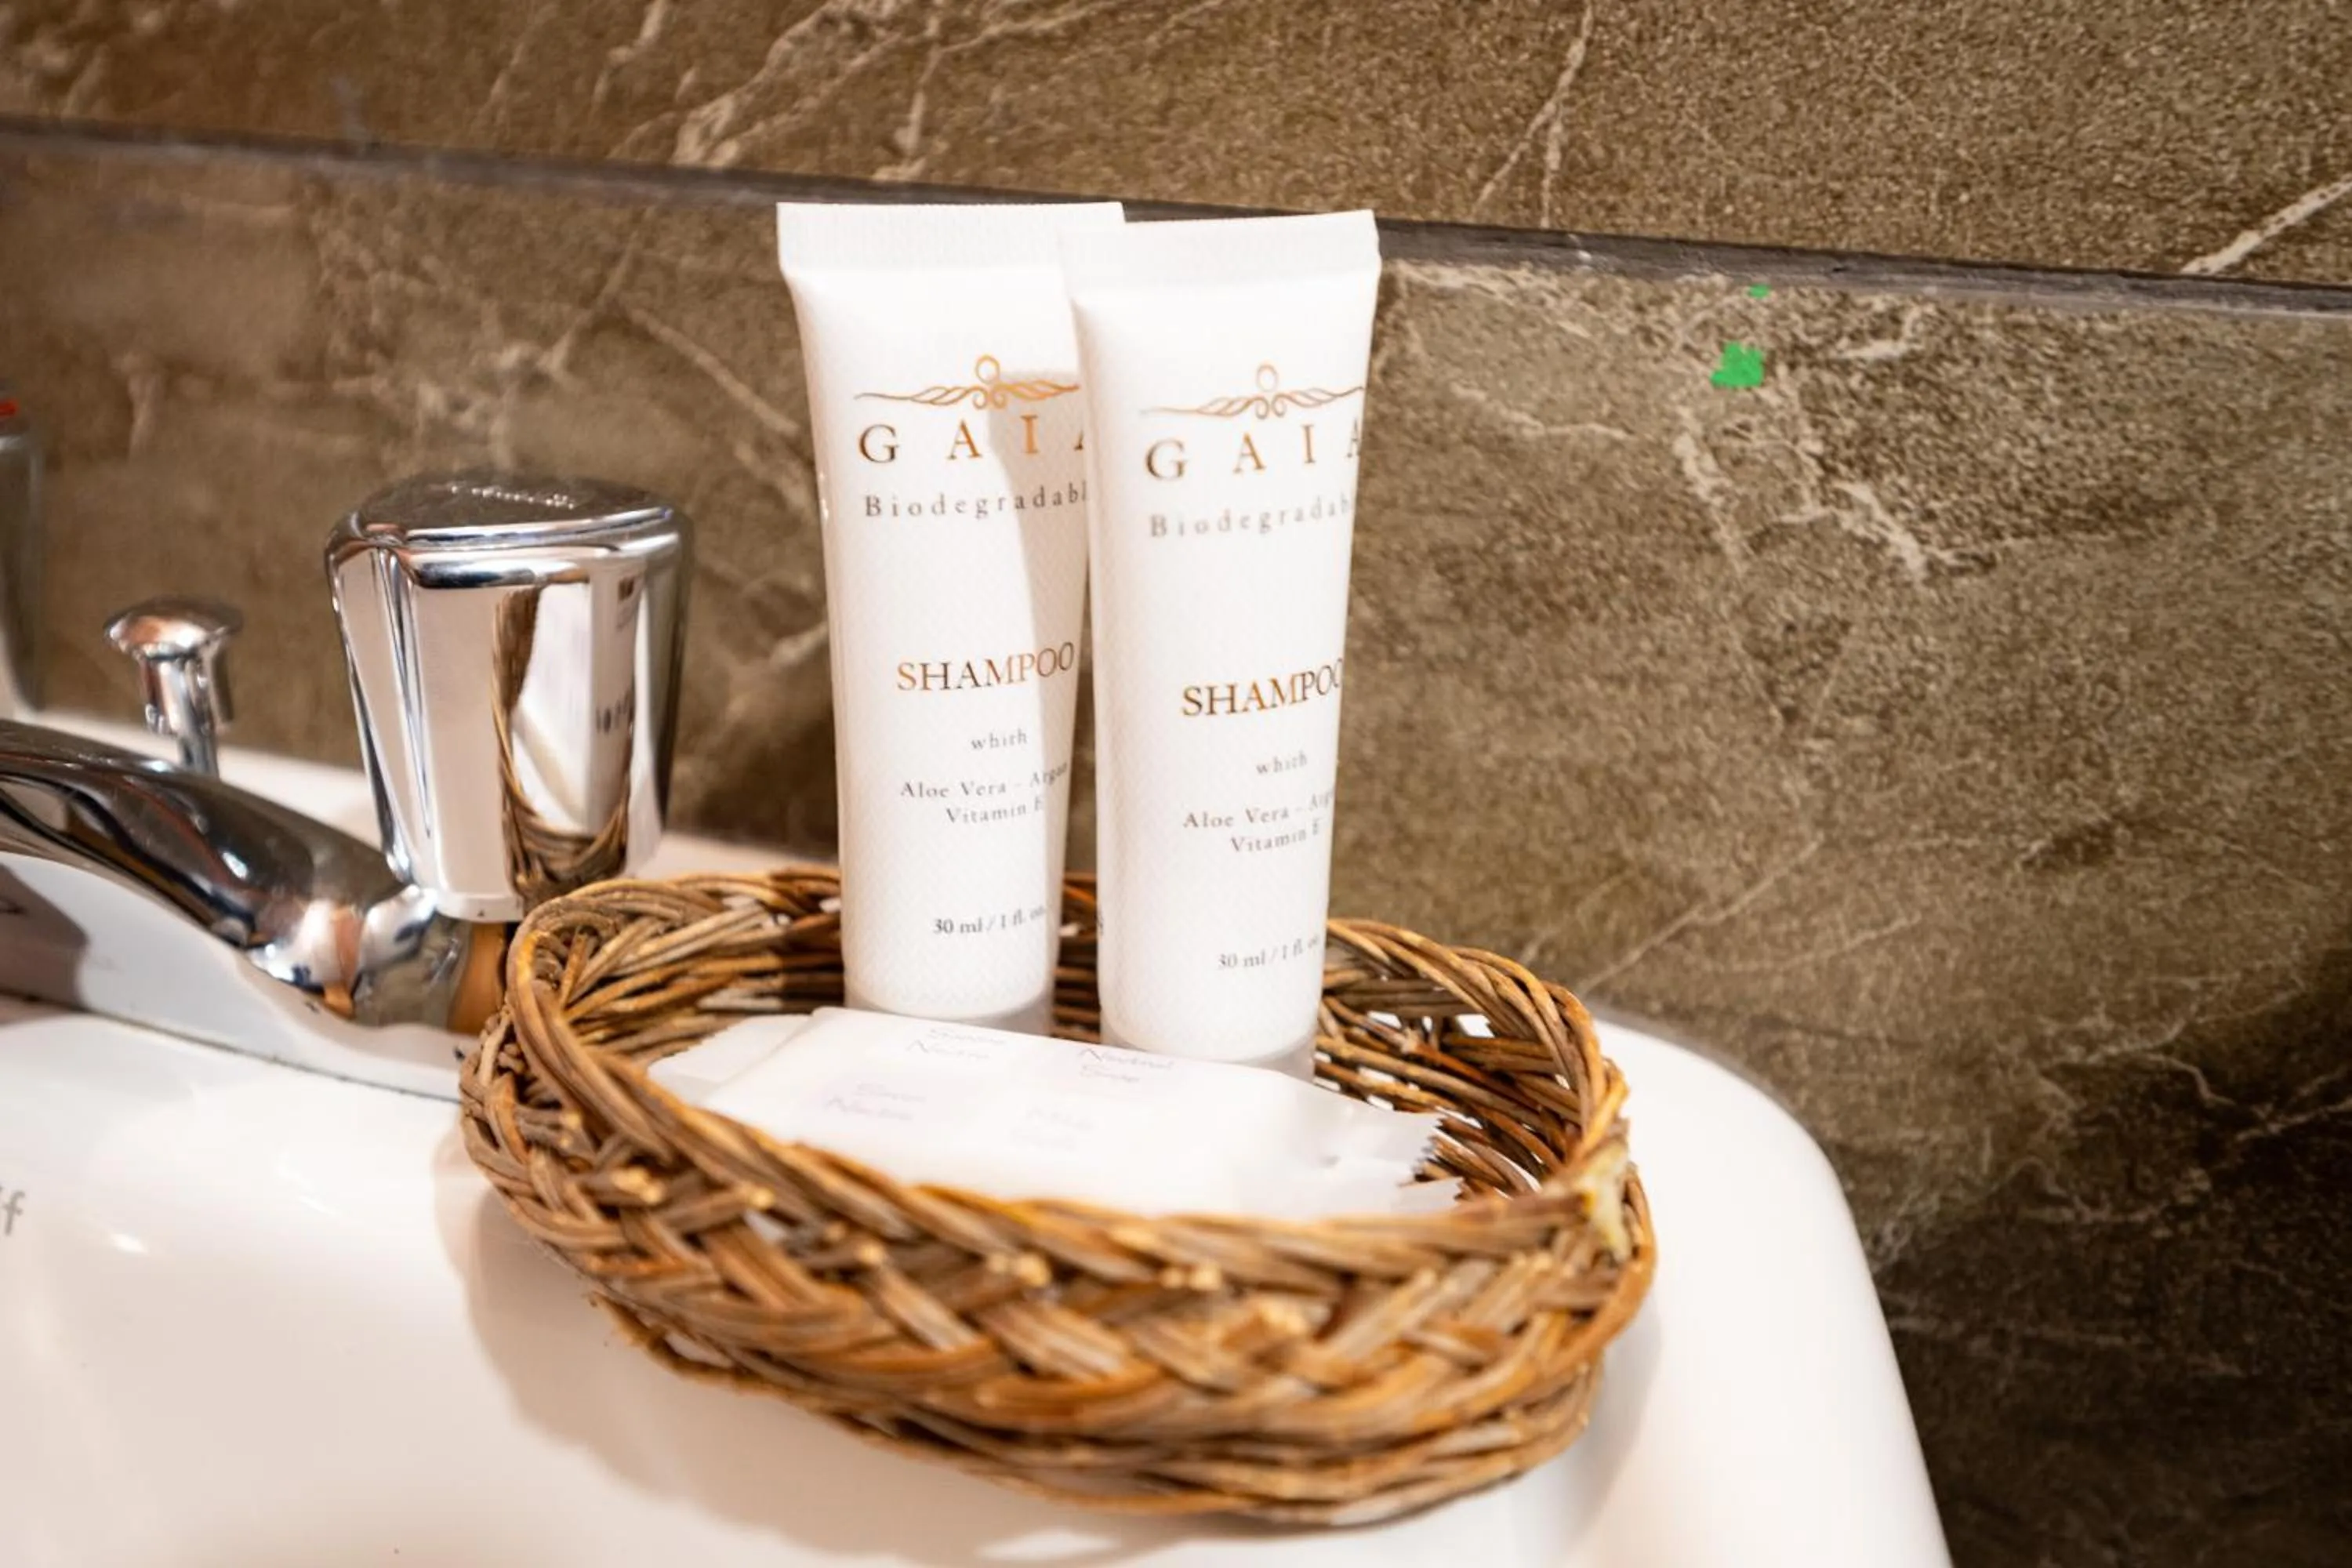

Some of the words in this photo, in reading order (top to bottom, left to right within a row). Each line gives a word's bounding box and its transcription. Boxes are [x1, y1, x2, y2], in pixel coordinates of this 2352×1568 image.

[897, 641, 1075, 691] SHAMPOO
[901, 782, 950, 799] Aloe
[961, 781, 1007, 797] Vera
[946, 802, 1027, 825] Vitamin
[1182, 812, 1234, 829] Aloe
[1245, 805, 1290, 825] Vera
[1231, 828, 1307, 853] Vitamin
[933, 918, 954, 935] 30
